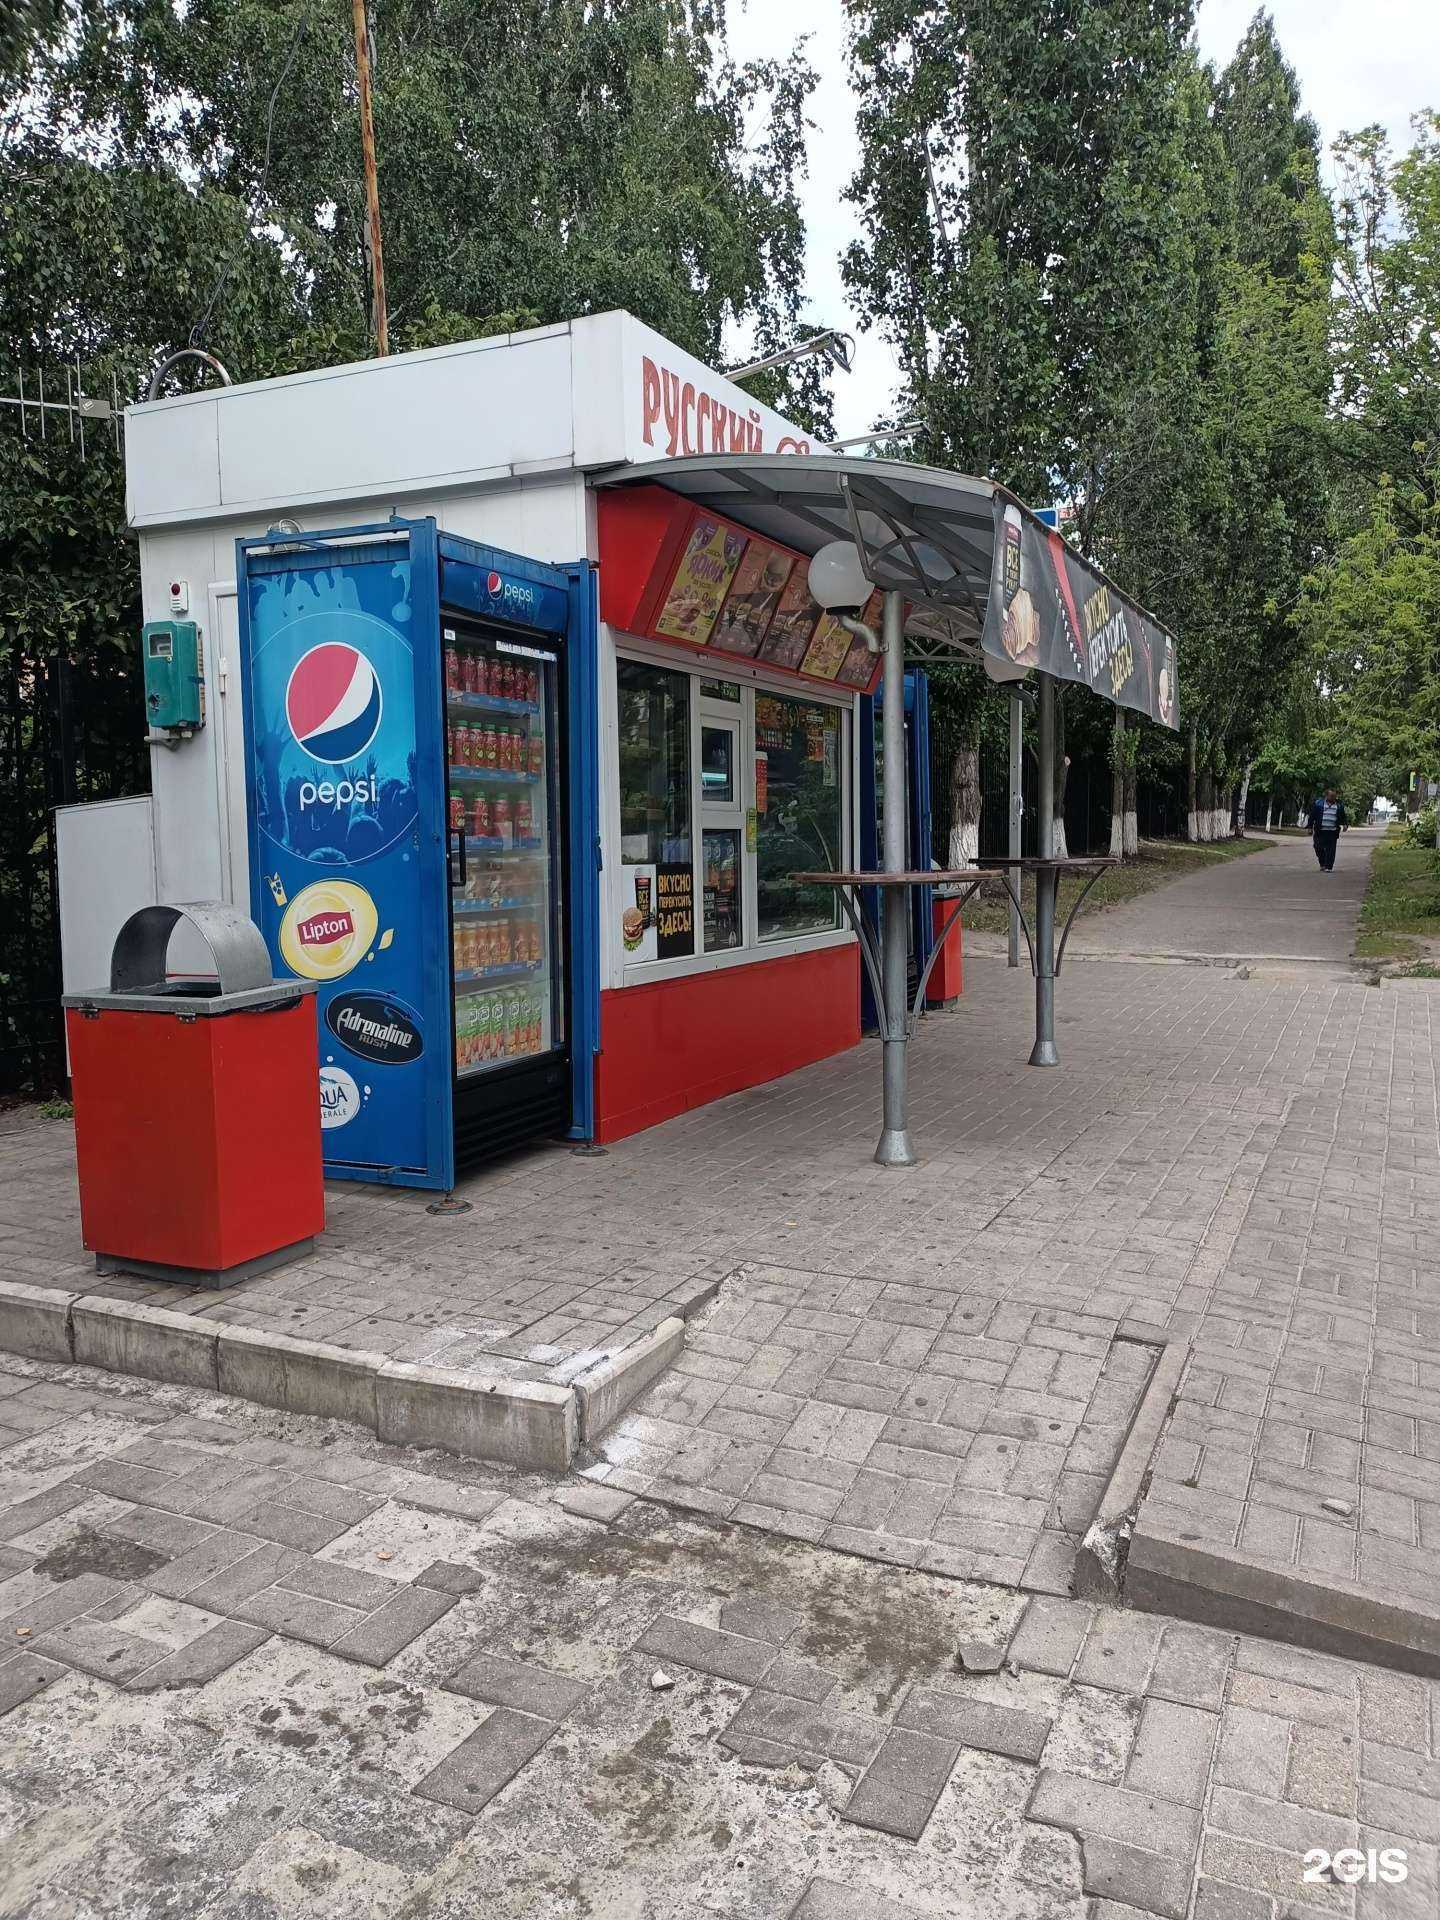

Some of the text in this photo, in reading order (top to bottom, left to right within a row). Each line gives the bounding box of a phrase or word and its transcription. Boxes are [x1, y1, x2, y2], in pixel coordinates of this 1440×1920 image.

[643, 356, 763, 457] РУССКИЙ
[504, 583, 533, 603] pepsi
[299, 773, 377, 811] pepsi
[658, 874, 691, 893] ВКУСНО
[658, 895, 692, 908] ПЕРЕКУСИТЬ
[301, 917, 349, 942] Lipton
[658, 910, 692, 937] ЗДЕСЬ!
[336, 1007, 413, 1048] Adrenaline
[358, 1034, 389, 1050] RUSH
